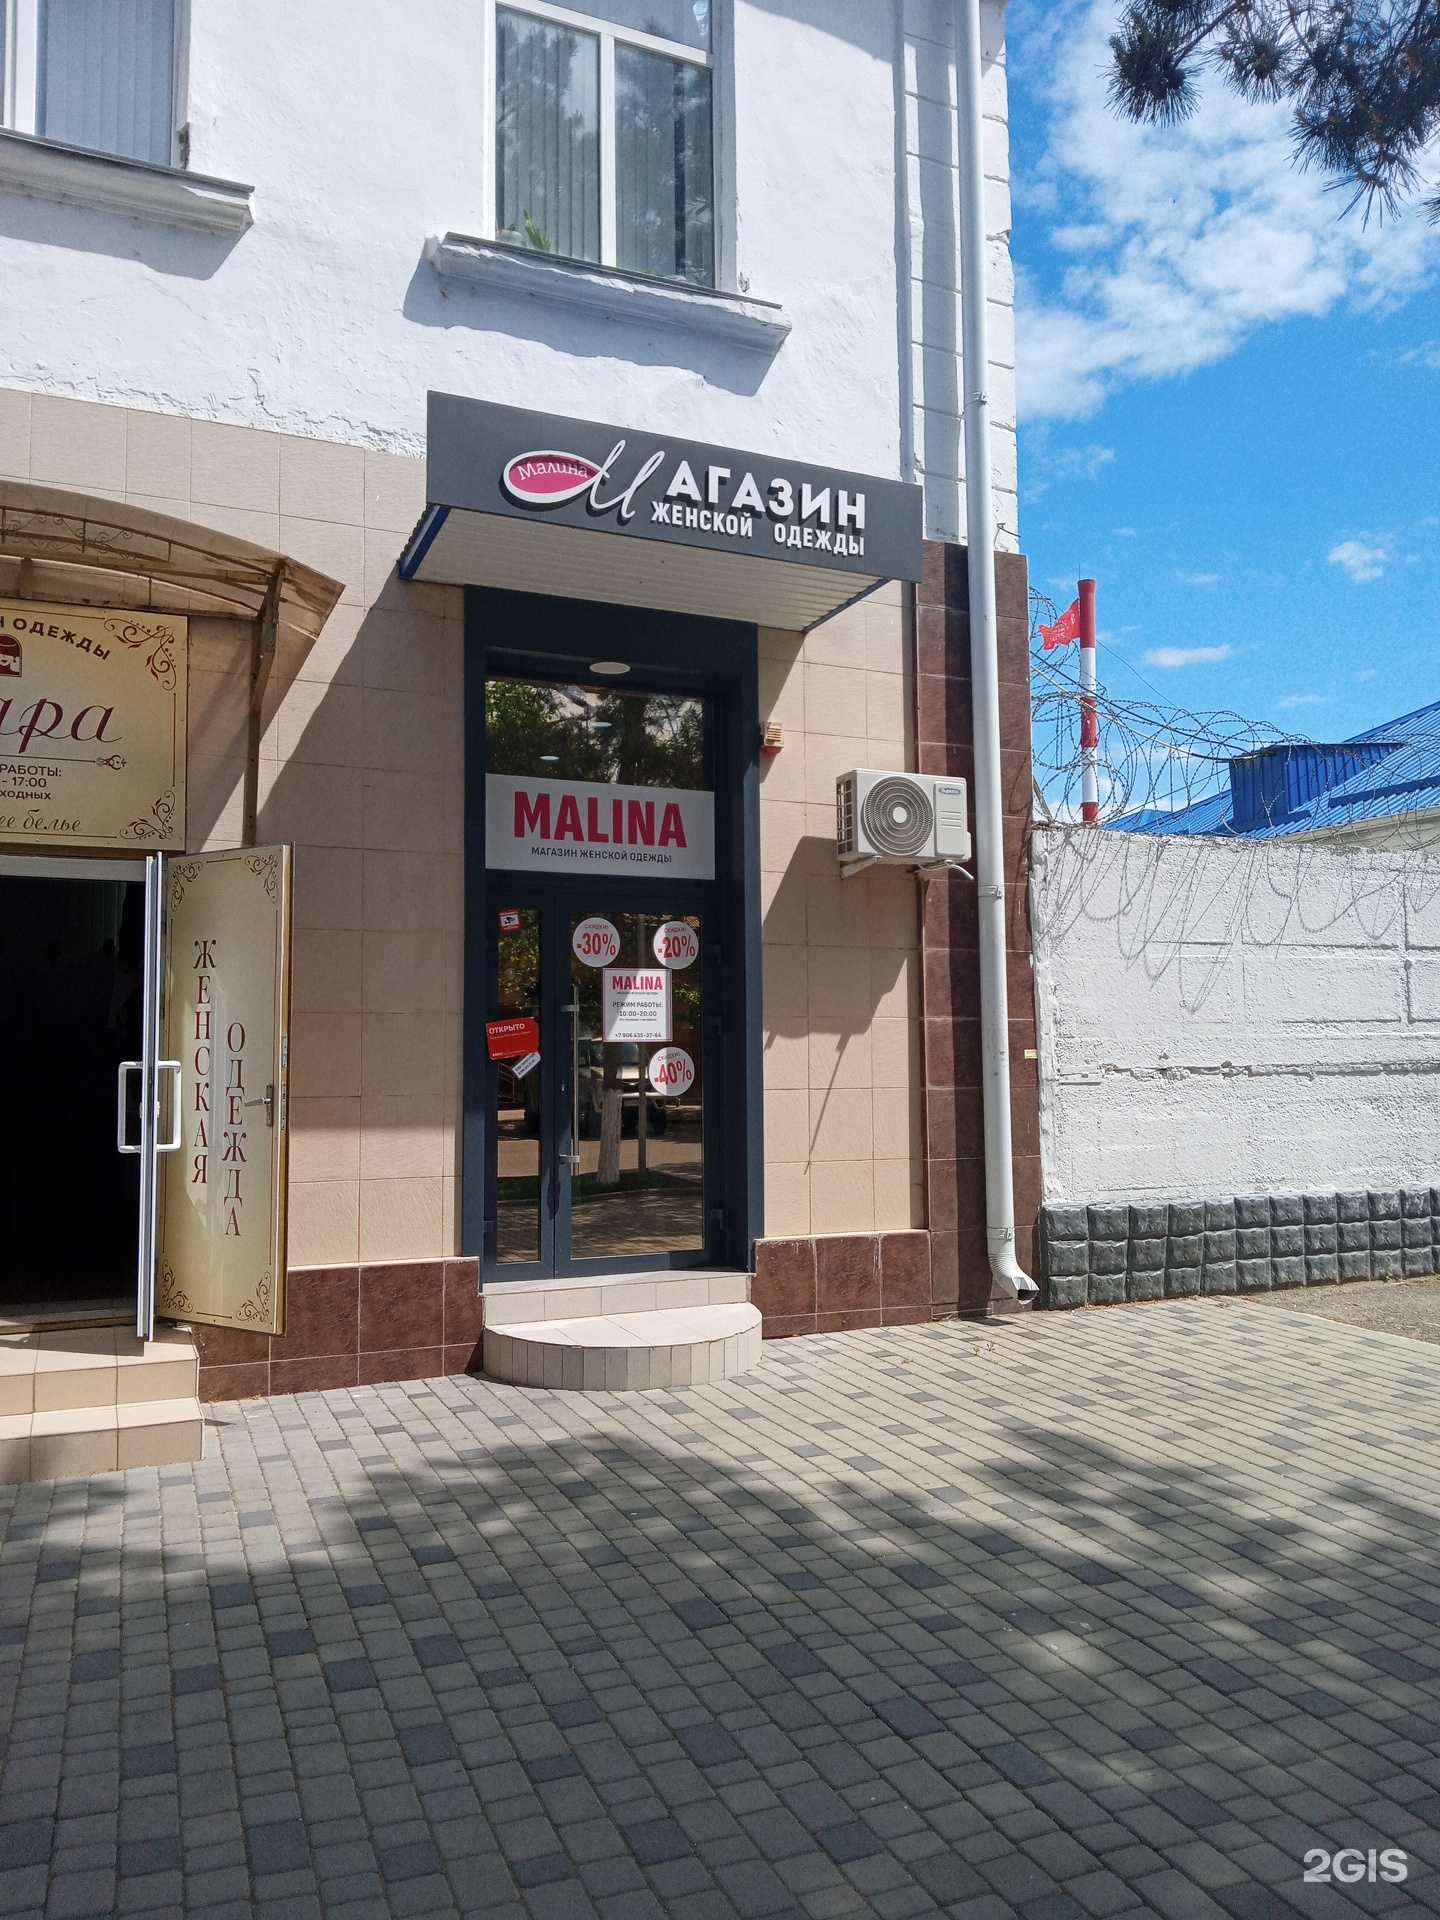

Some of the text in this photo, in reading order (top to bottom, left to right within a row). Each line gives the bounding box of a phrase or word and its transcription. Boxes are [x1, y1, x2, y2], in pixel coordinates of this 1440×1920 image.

[517, 461, 588, 480] Малина
[651, 500, 865, 556] ЖЕНСКОЙ ОДЕЖДЫ
[12, 618, 110, 660] ОДЕЖДЫ
[0, 764, 62, 777] РАБОТЫ:
[12, 776, 47, 788] 17:00
[514, 791, 688, 848] MALINA
[531, 846, 672, 864] МАГАЗИН ЖЕНСКОЙ ОДЕЖДЫ
[577, 932, 616, 957] -30%
[658, 935, 696, 958] -20%
[612, 976, 663, 990] MALINA
[489, 1023, 526, 1035] ОТКРЫТО
[192, 939, 217, 1184] ЖЕНСКАЯ
[655, 1058, 692, 1085] -40%
[222, 1022, 247, 1236] ОДЕЖДА
